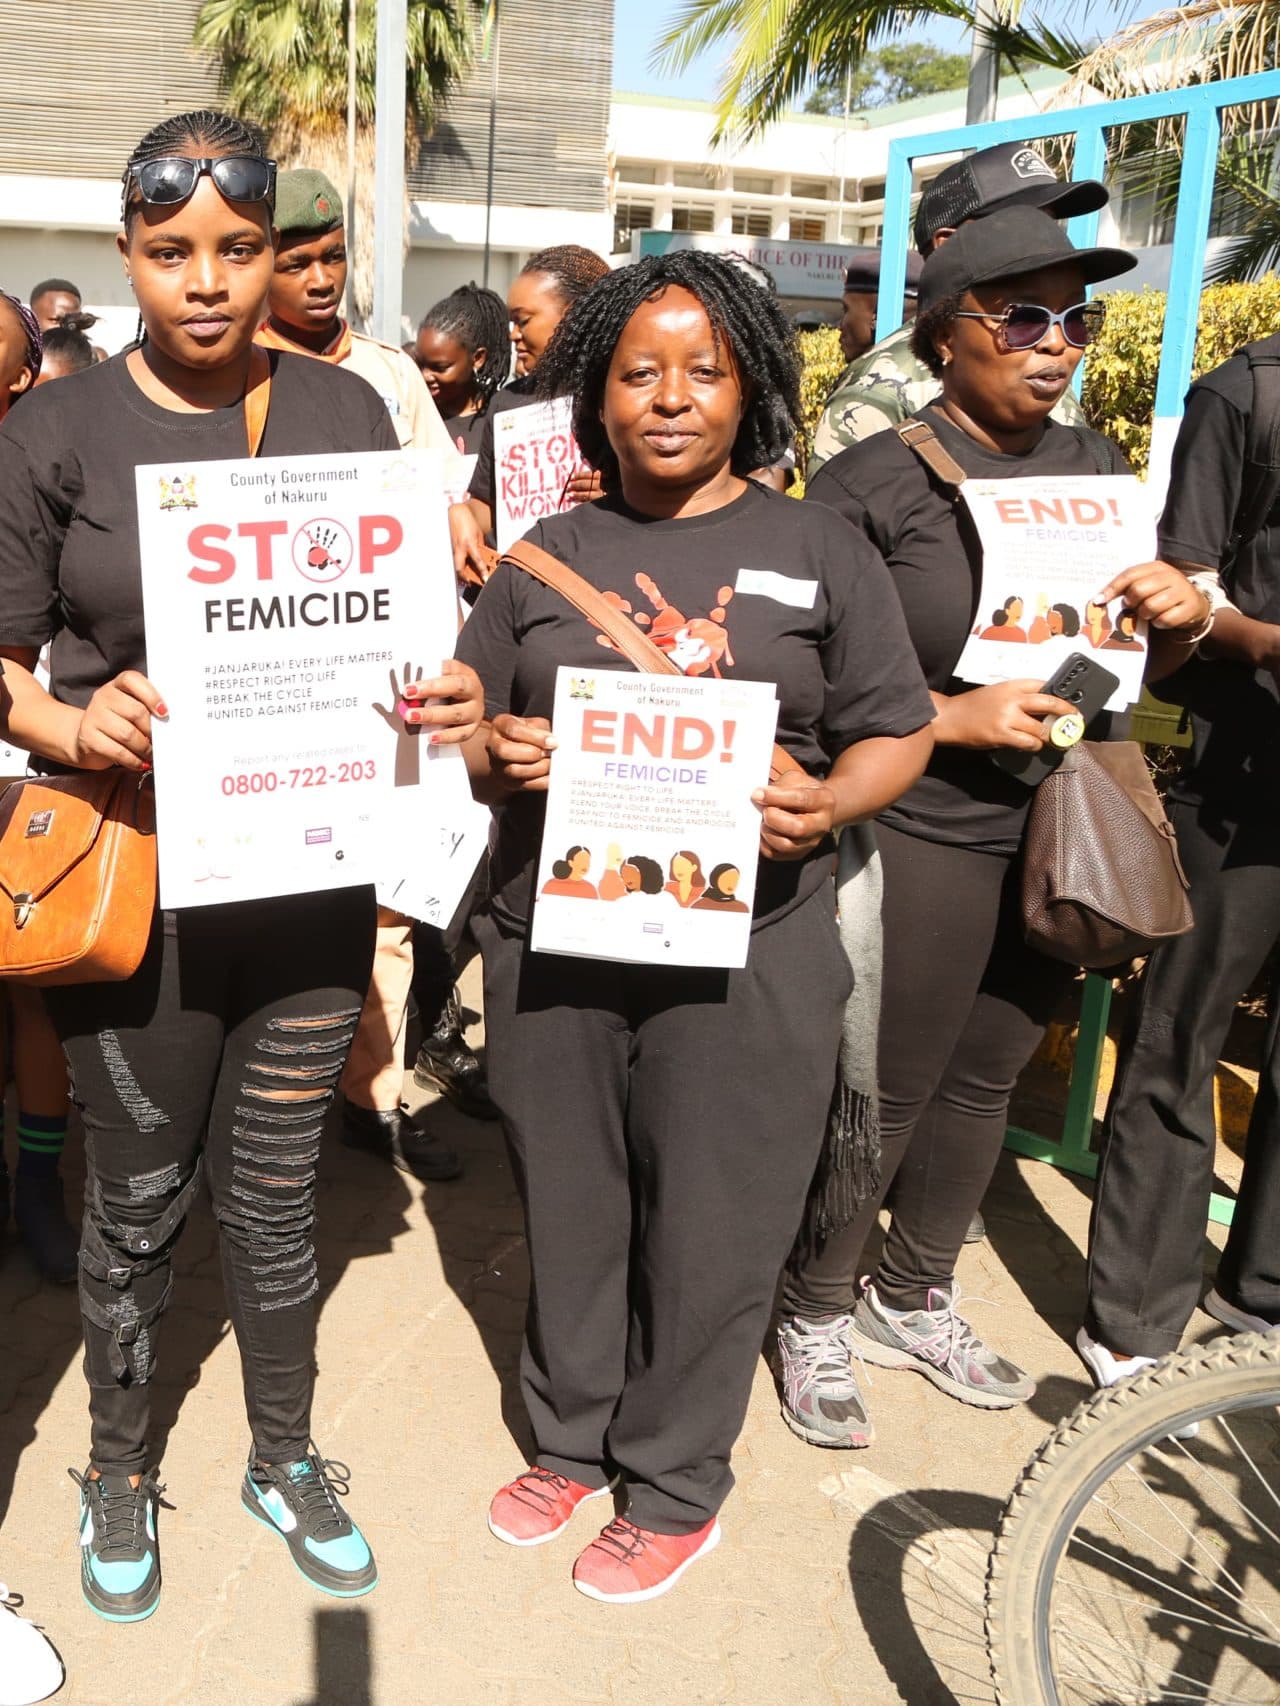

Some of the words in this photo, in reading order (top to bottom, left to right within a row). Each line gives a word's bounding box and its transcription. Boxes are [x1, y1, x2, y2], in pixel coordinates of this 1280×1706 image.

[790, 251, 810, 267] OF
[230, 472, 276, 487] County
[281, 467, 358, 484] Government
[264, 491, 276, 504] of
[282, 489, 327, 504] Nakuru
[994, 498, 1124, 526] END!
[1026, 528, 1109, 543] FEMICIDE
[205, 588, 391, 633] FEMICIDE
[289, 658, 322, 669] EVERY
[326, 655, 345, 666] LIFE
[347, 650, 393, 664] MATTERS
[205, 677, 260, 689] #RESPECT
[264, 674, 297, 686] RIGHT
[300, 672, 314, 683] TO
[317, 670, 337, 681] LIFE
[616, 680, 647, 693] County
[650, 682, 704, 696] Government
[206, 693, 250, 705] #BREAK
[254, 691, 273, 702] THE
[276, 688, 313, 700] CYCLE
[648, 697, 681, 707] Nakuru
[207, 707, 254, 720] #UNITED
[258, 702, 307, 716] AGAINST
[310, 697, 359, 711] FEMICIDE
[581, 709, 737, 763] END!
[221, 759, 377, 796] 0800-722-203
[604, 762, 709, 785] FEMICIDE
